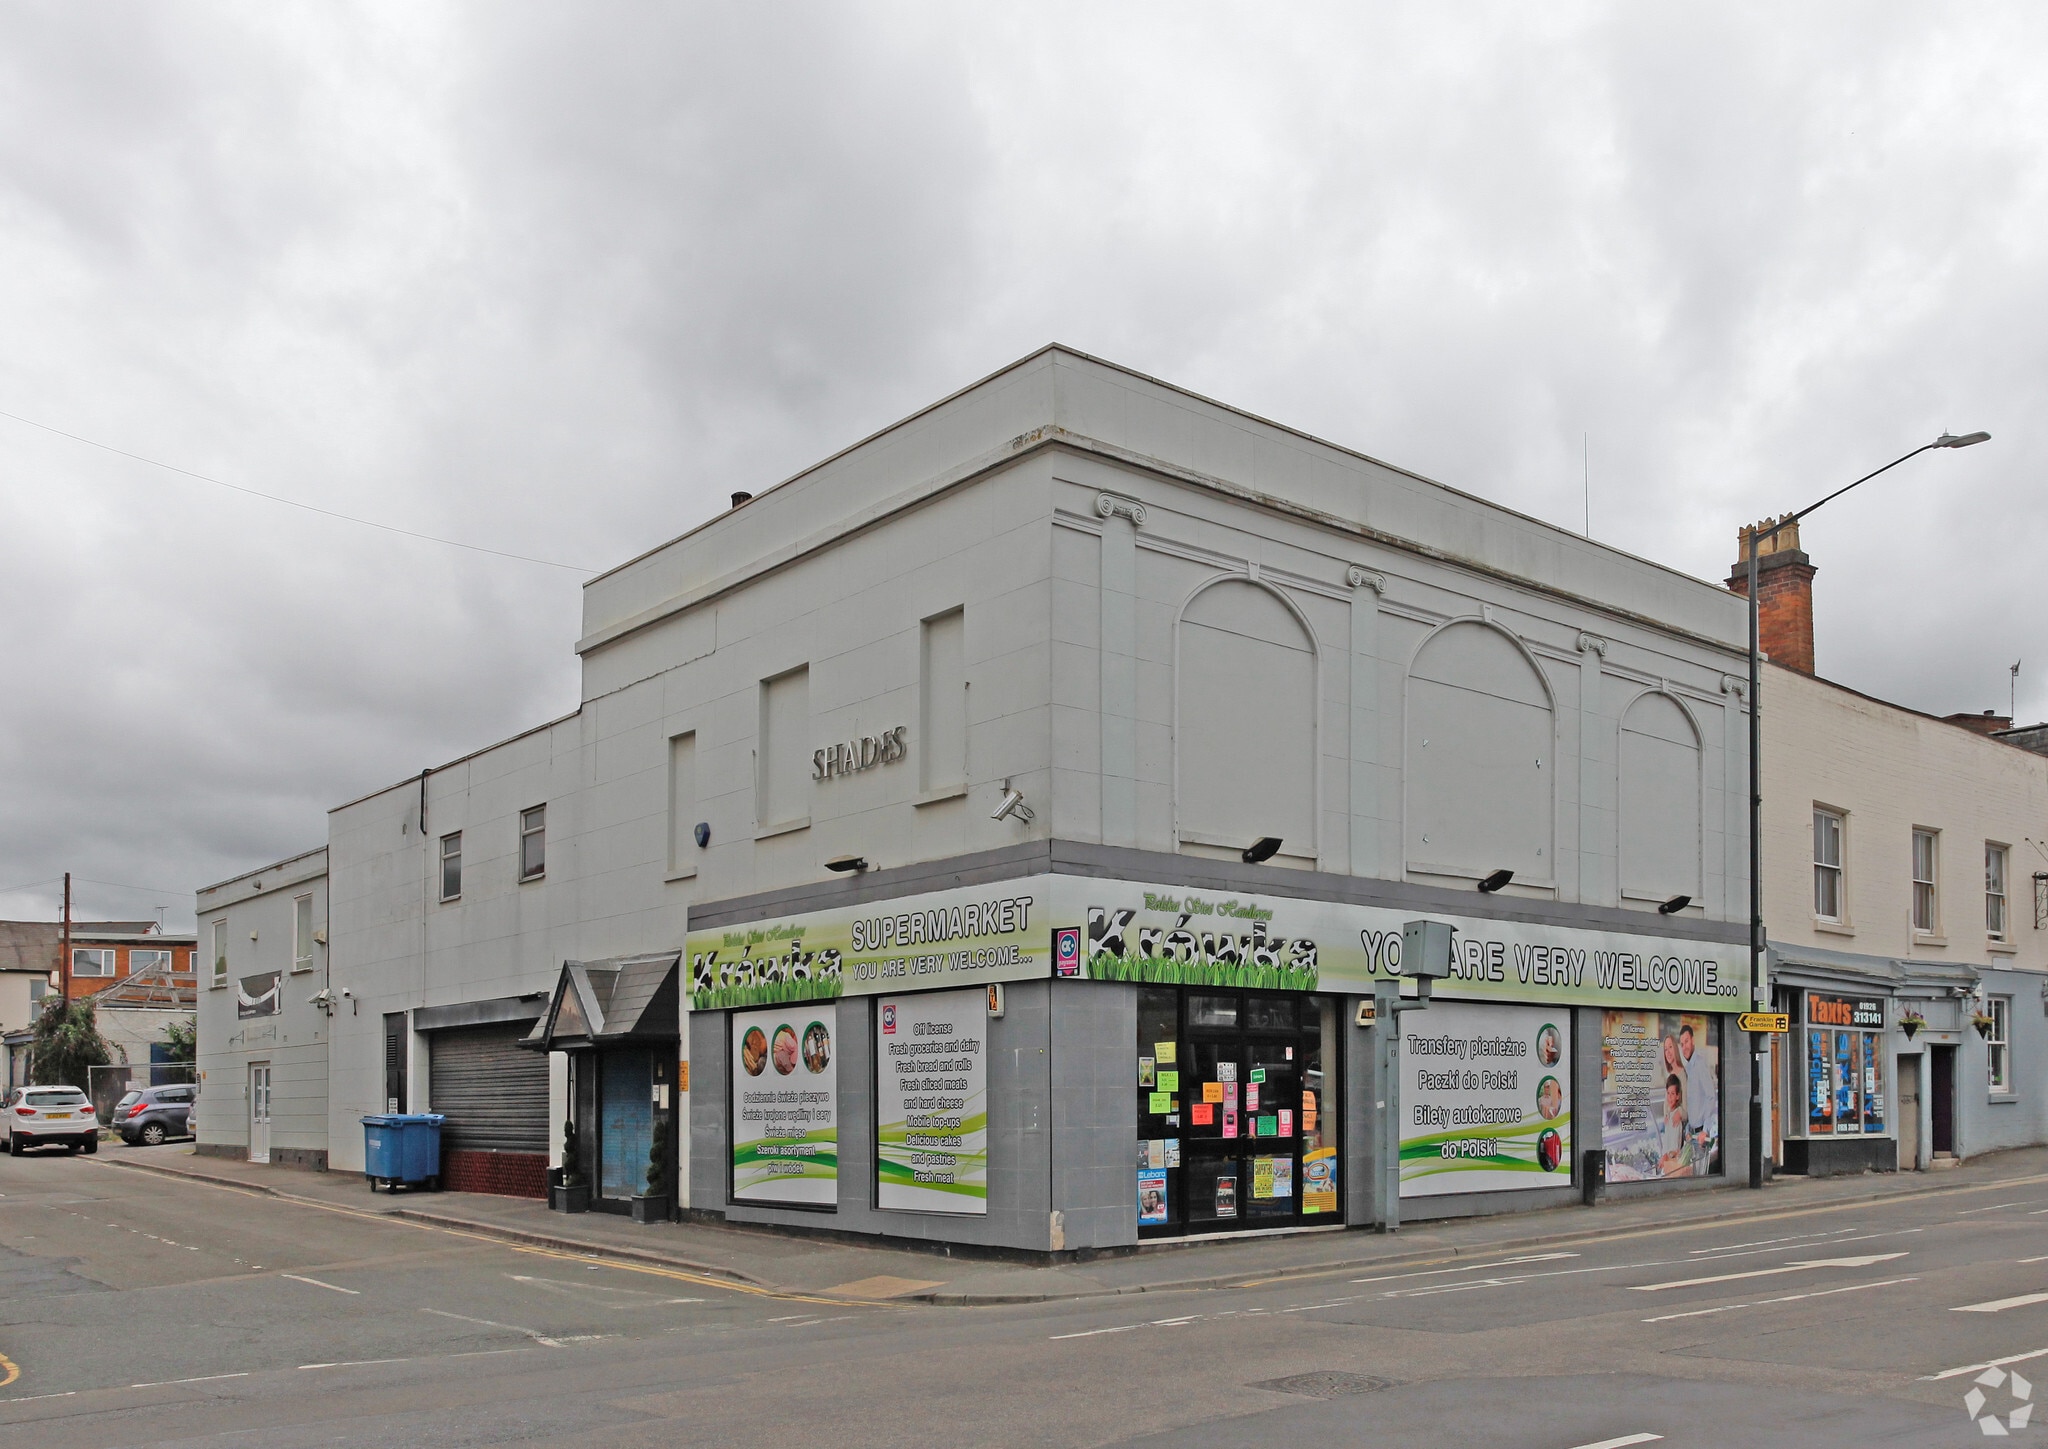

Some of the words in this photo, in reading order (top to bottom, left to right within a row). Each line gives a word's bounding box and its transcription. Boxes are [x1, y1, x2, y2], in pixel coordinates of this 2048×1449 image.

[812, 725, 907, 780] SHADES
[852, 896, 1034, 952] SUPERMARKET
[1087, 907, 1318, 974] Krówka
[694, 939, 843, 995] Krówka
[852, 960, 877, 980] YOU
[881, 958, 906, 978] ARE
[909, 953, 944, 975] VERY
[948, 945, 1033, 971] WELCOME...
[1360, 929, 1404, 977] YO
[1450, 937, 1505, 982] ARE
[1514, 943, 1586, 987] VERY
[1594, 950, 1738, 997] WELCOME...
[1809, 994, 1852, 1025] Taxis
[1853, 1011, 1882, 1024] 313141
[913, 1022, 925, 1036] Off
[926, 1022, 953, 1035] license
[888, 1042, 909, 1056] Fresh
[909, 1040, 943, 1057] groceries
[944, 1040, 959, 1053] and
[960, 1038, 980, 1054] dairy
[1407, 1034, 1467, 1059] Transfery
[895, 1060, 916, 1073] Fresh
[917, 1059, 938, 1073] bread
[939, 1058, 954, 1072] and
[954, 1058, 973, 1071] rolls
[900, 1078, 921, 1091] Fresh
[921, 1077, 943, 1091] sliced
[944, 1078, 968, 1091] meats
[1418, 1069, 1460, 1090] Paczki
[1462, 1070, 1479, 1089] do
[1481, 1070, 1518, 1090] Polski
[799, 1090, 830, 1105] pieczywo
[903, 1097, 918, 1109] and
[919, 1097, 936, 1109] hard
[937, 1096, 964, 1109] cheese
[816, 1109, 831, 1122] sery
[906, 1114, 931, 1128] Mobile
[931, 1116, 961, 1130] top-ups
[1413, 1104, 1450, 1129] Bilety
[1452, 1104, 1522, 1125] autokarowe
[906, 1133, 938, 1146] Delicious
[940, 1134, 962, 1147] cakes
[756, 1143, 779, 1156] Szeroki
[780, 1144, 816, 1157] asortyment
[1441, 1139, 1457, 1160] do
[1460, 1138, 1498, 1158] Polski
[911, 1152, 925, 1164] and
[926, 1152, 956, 1167] pastries
[913, 1170, 934, 1183] Fresh
[935, 1172, 955, 1184] meat
